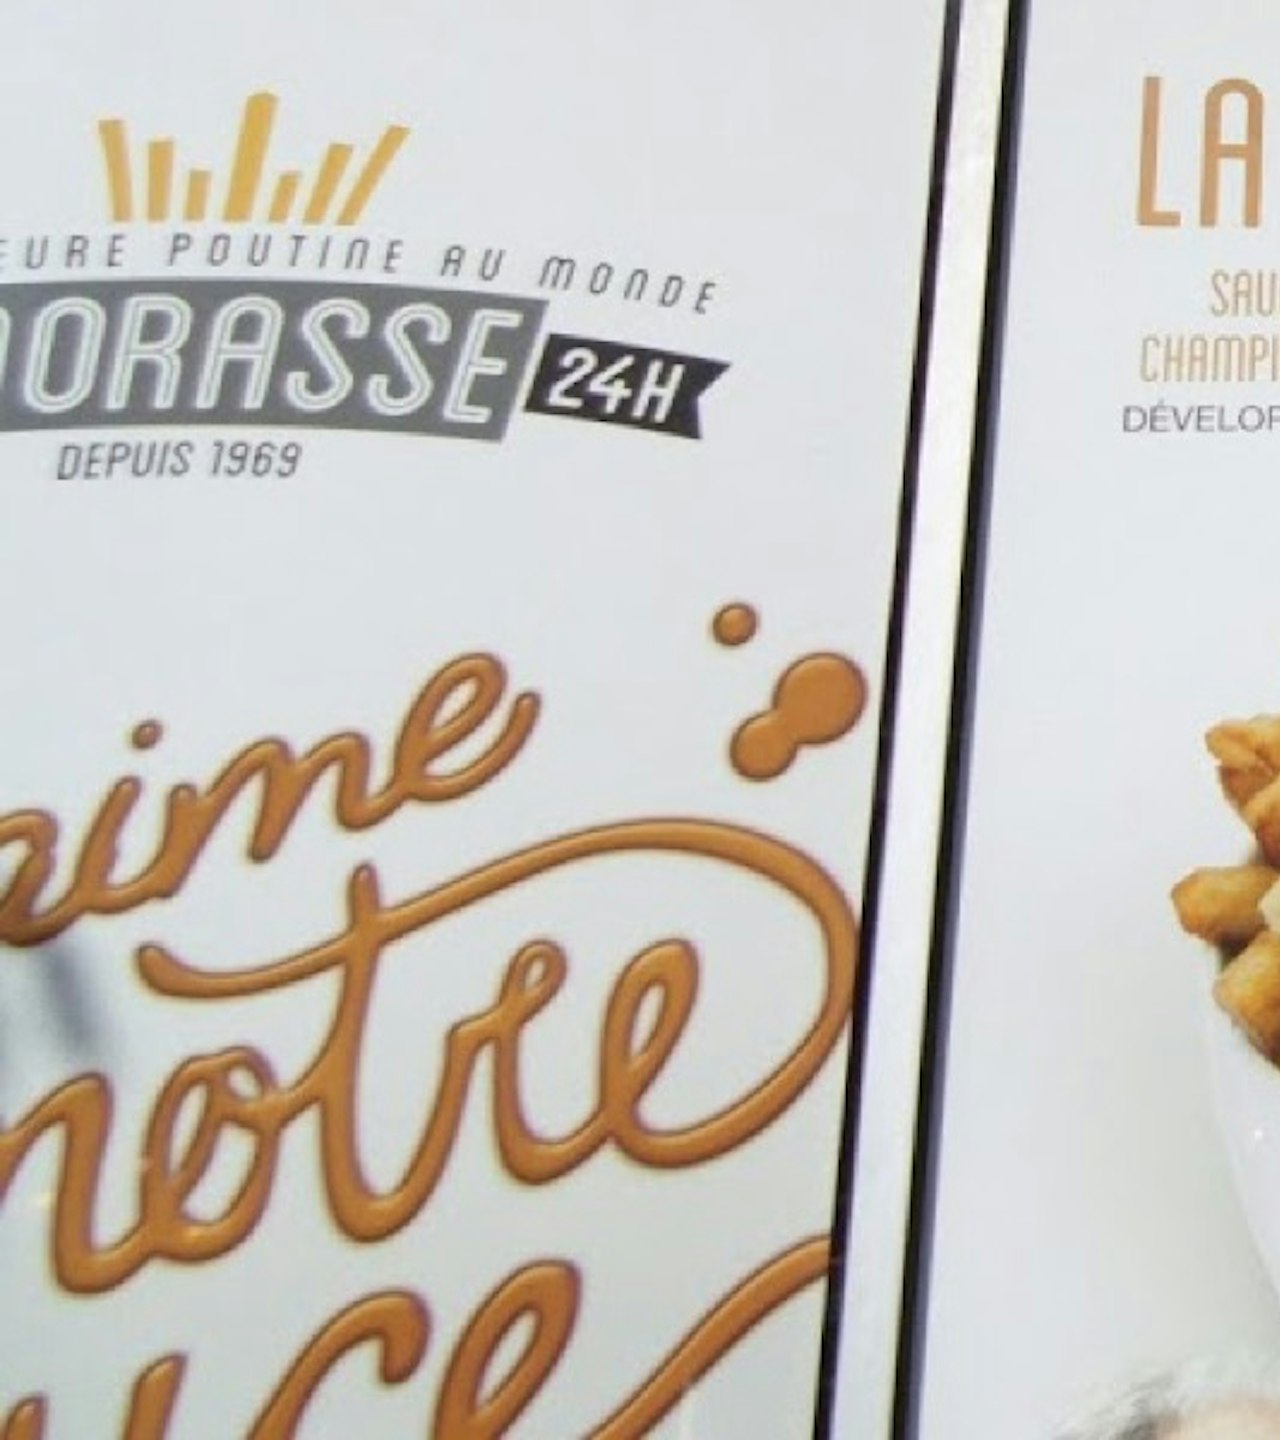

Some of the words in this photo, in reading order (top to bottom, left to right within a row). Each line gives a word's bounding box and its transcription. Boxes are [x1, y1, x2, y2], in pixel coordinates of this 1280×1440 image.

[1137, 75, 1264, 228] LA
[166, 233, 404, 274] POUTINE
[440, 244, 506, 282] AU
[538, 256, 716, 315] MONDE
[0, 294, 523, 424] ORASSE
[548, 346, 686, 425] 24H
[57, 441, 193, 481] DEPUIS
[209, 440, 304, 480] 1969
